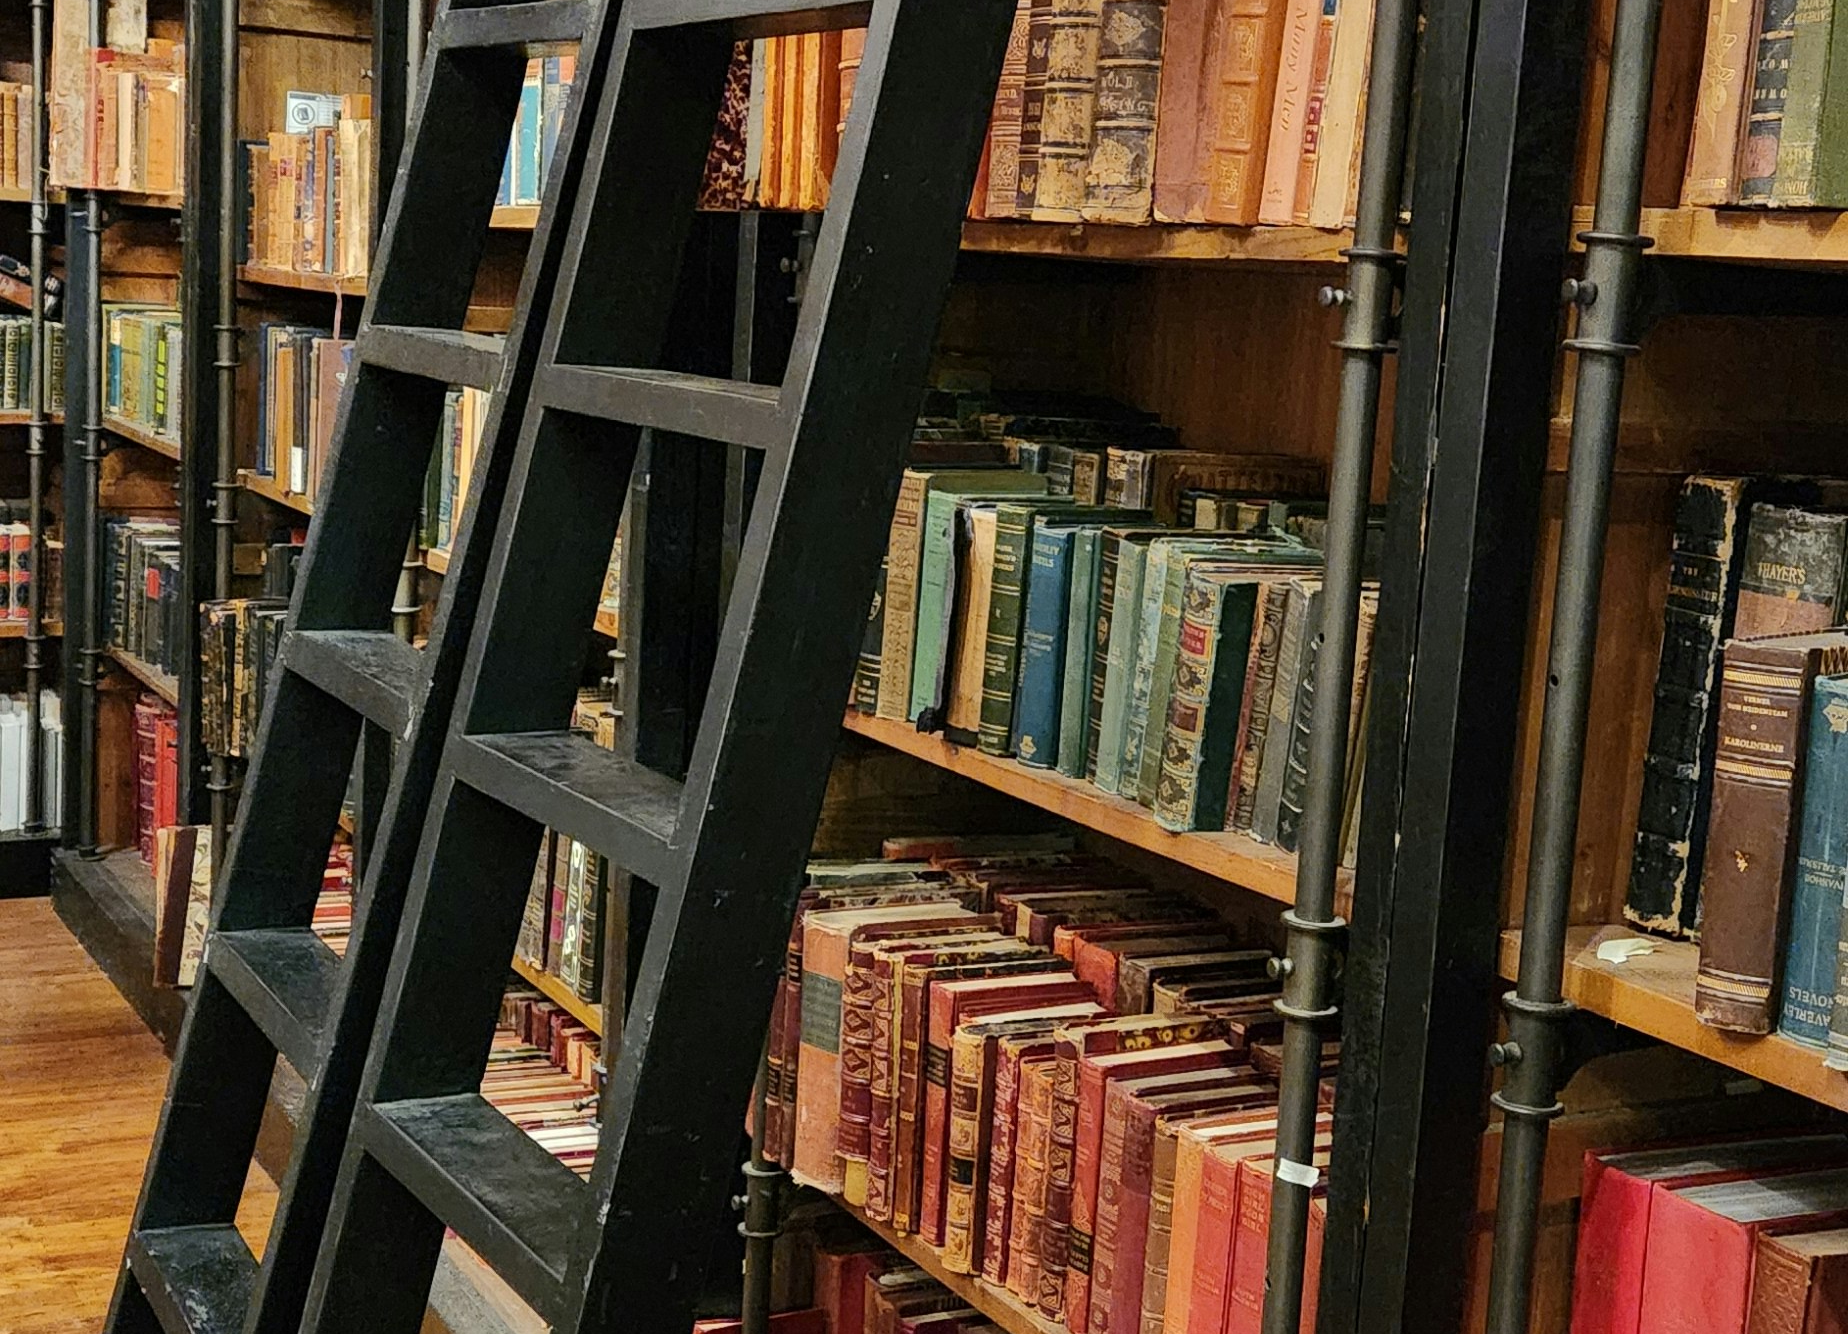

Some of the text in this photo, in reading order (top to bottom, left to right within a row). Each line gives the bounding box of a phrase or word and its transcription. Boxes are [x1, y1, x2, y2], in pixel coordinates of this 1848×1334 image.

[1285, 9, 1309, 75] Many
[1280, 84, 1299, 133] Men
[1783, 1002, 1831, 1027] AVERLEY
